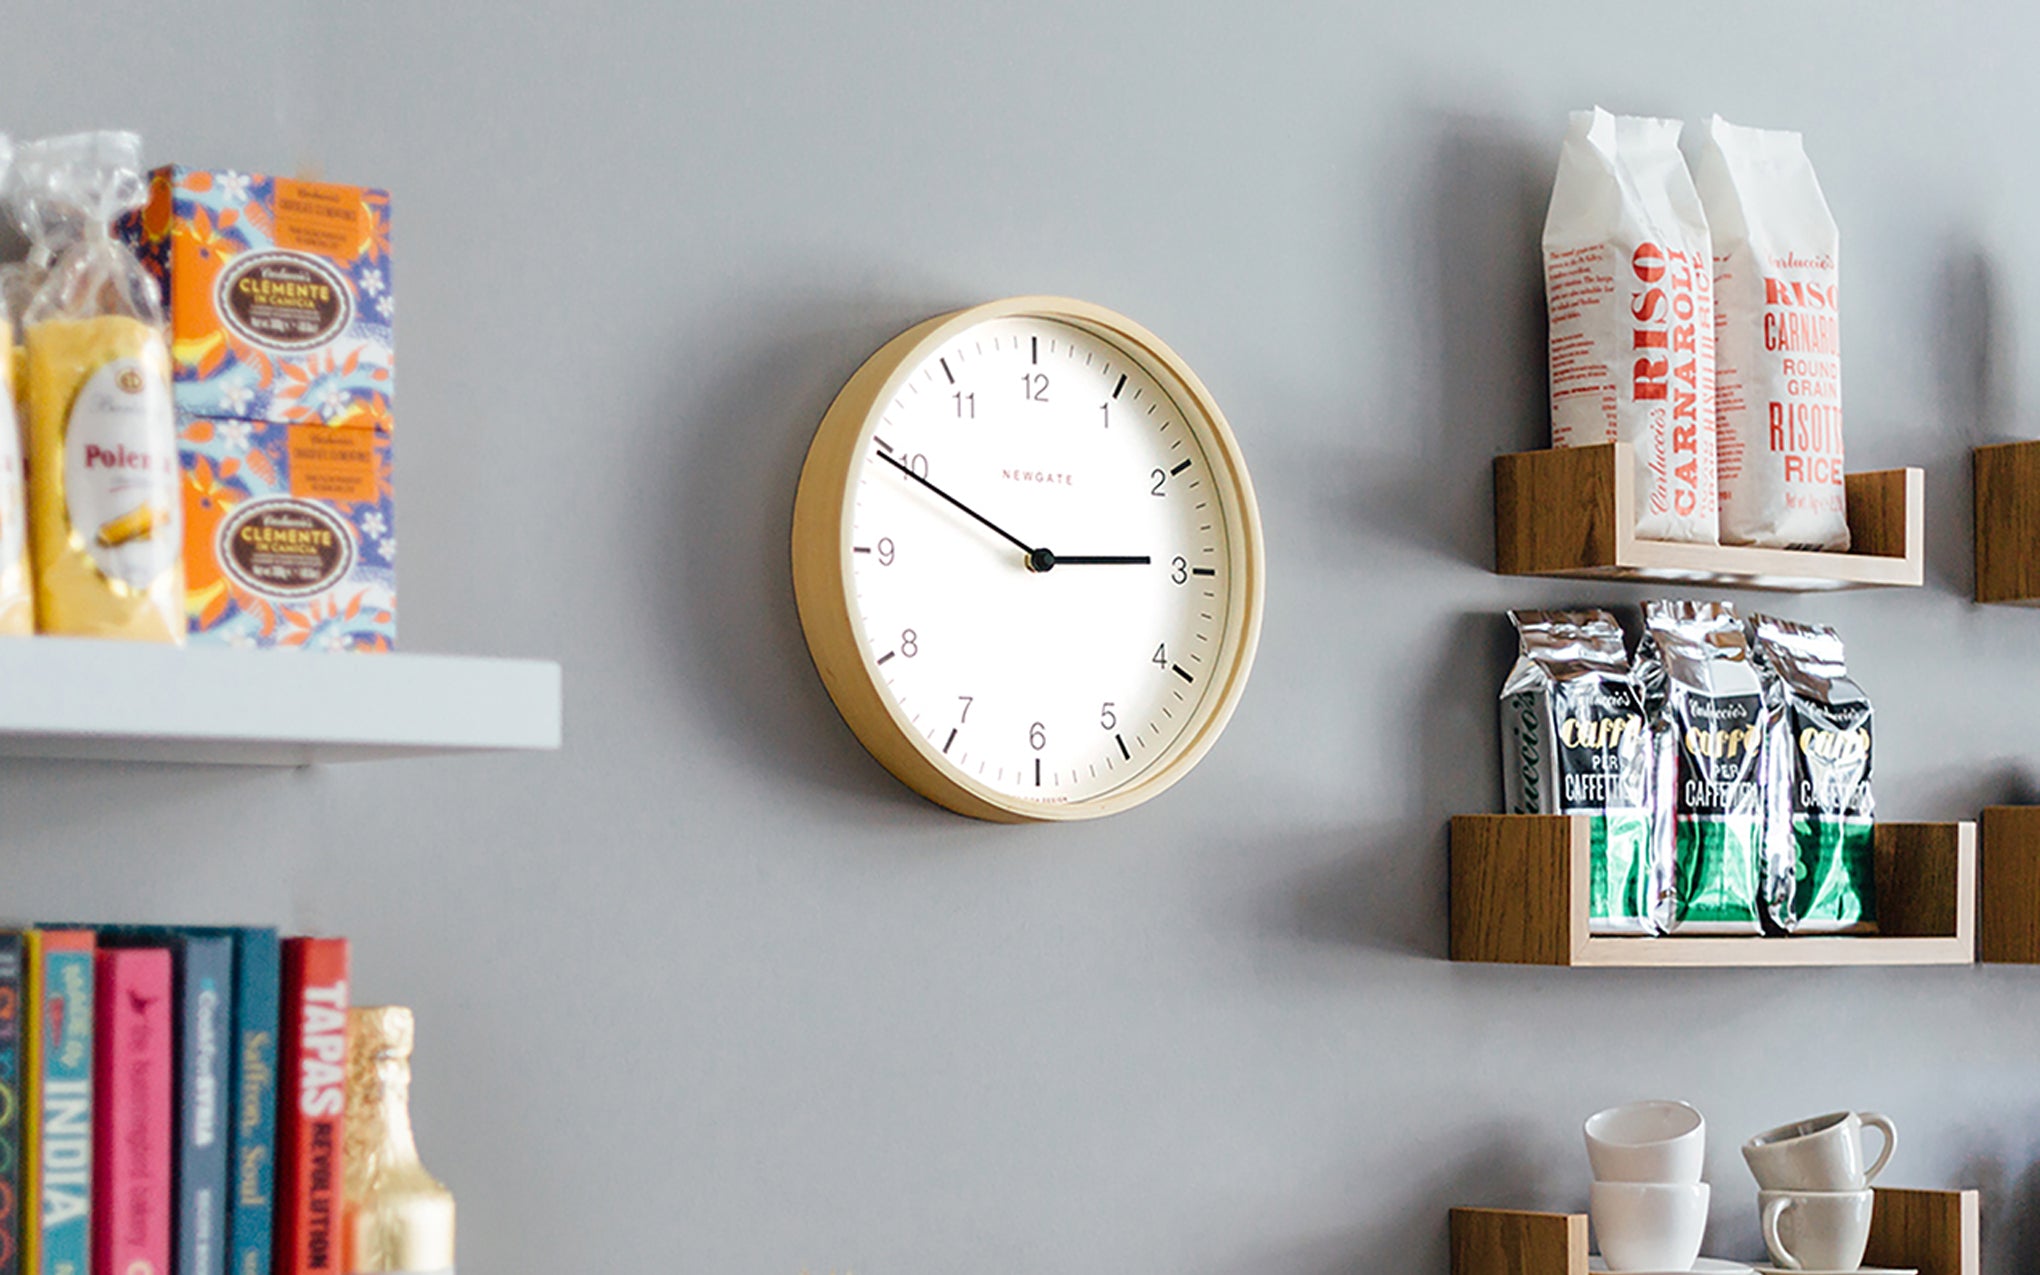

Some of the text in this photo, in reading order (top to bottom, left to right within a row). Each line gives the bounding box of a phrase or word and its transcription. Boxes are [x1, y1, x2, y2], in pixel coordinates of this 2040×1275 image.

[240, 278, 329, 303] CLEMENTE
[1632, 242, 1668, 402] RISO
[1022, 373, 1049, 402] 12
[1667, 247, 1697, 516] CARNAROLI
[1787, 379, 1838, 399] GRAIN
[953, 391, 975, 419] 11
[1100, 402, 1109, 429] 1
[899, 453, 928, 481] 10
[1002, 469, 1072, 486] NEWGATE
[1785, 455, 1842, 485] RICE
[1150, 468, 1167, 497] 2
[241, 526, 331, 547] CLEMENTE
[877, 537, 895, 567] 9
[1171, 556, 1189, 586] 3
[901, 628, 918, 658] 8
[1151, 642, 1168, 670] 4
[958, 695, 974, 724] 7
[1100, 702, 1117, 731] 5
[1029, 721, 1046, 751] 6
[301, 980, 347, 1270] TAPAS REVOLUTION
[44, 1080, 91, 1228] INDIA
[240, 1145, 266, 1206] Soul
